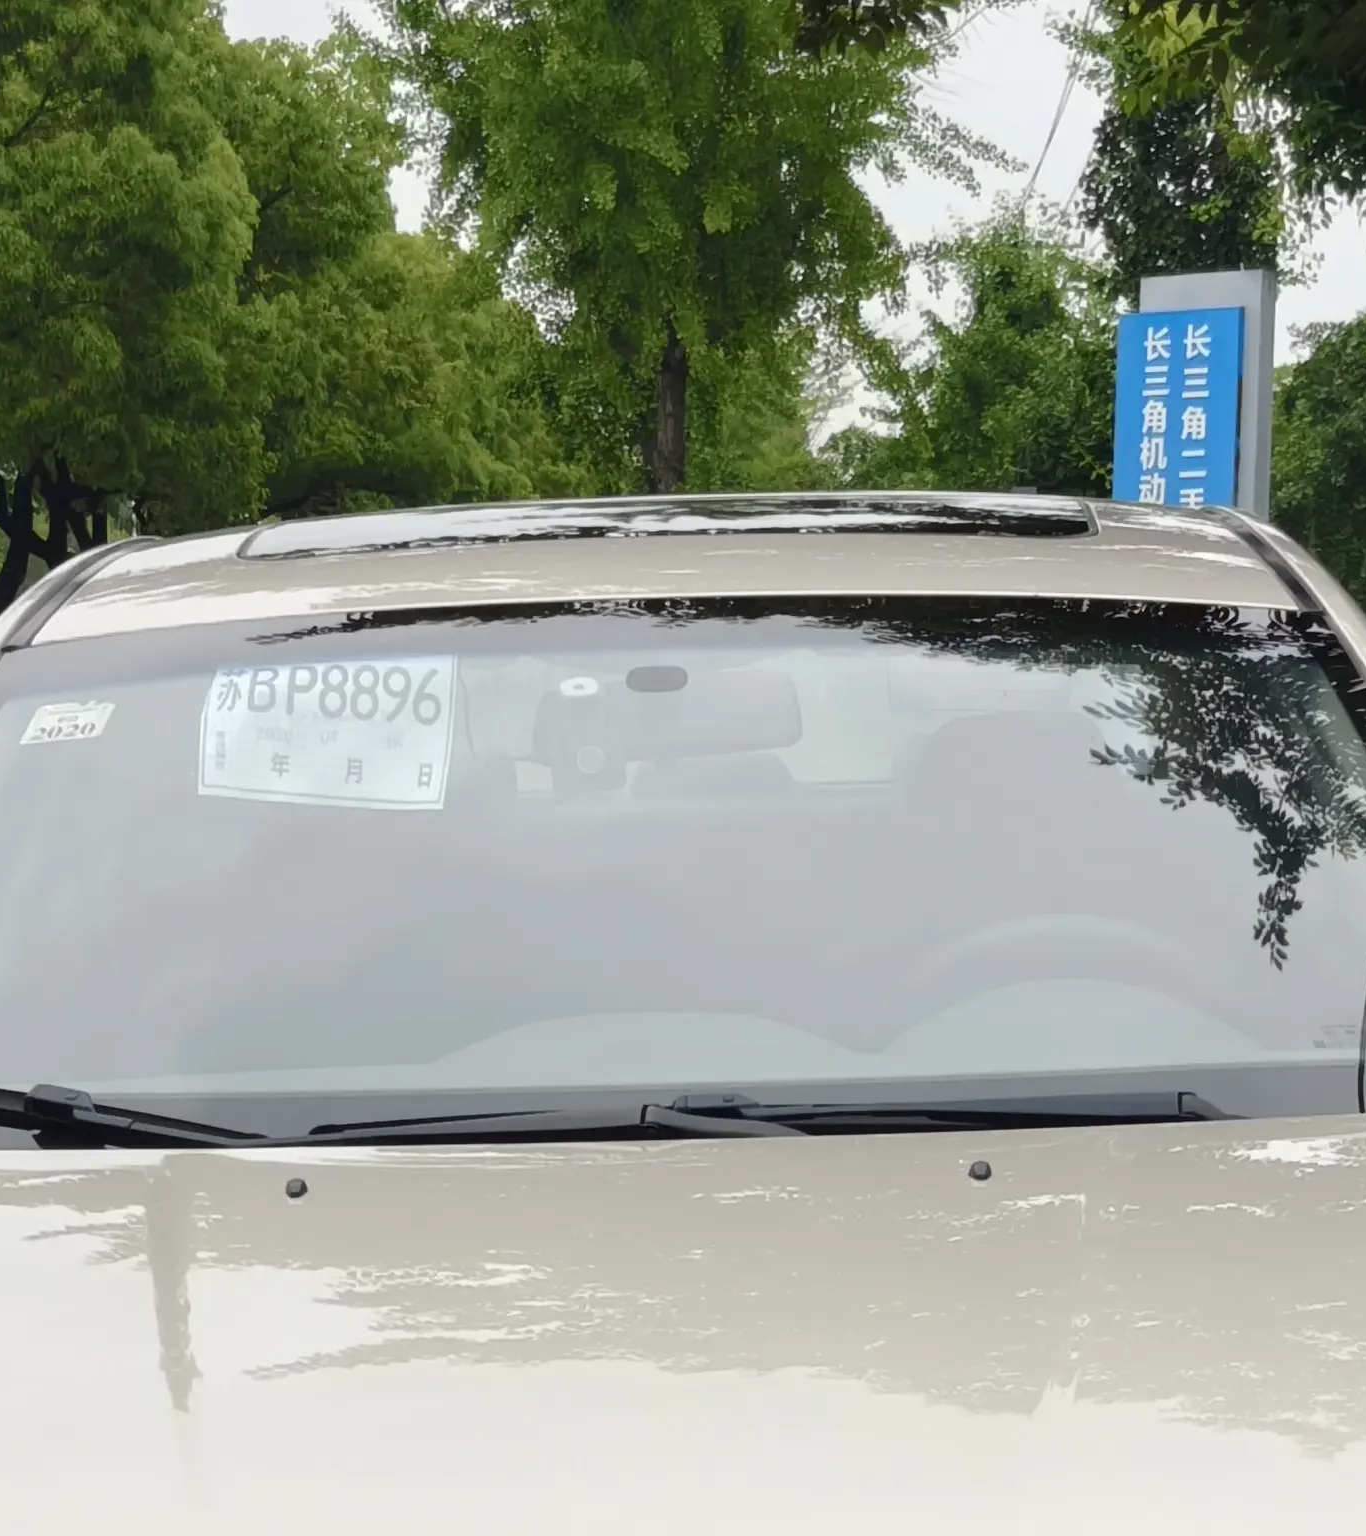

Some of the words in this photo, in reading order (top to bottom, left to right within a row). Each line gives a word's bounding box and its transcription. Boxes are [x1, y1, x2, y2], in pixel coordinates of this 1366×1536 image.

[1138, 326, 1172, 505] 长三角机动
[216, 664, 442, 726] 苏BP8896
[29, 721, 96, 741] 2020
[270, 752, 291, 778] 年
[345, 757, 364, 784] 月
[417, 763, 433, 789] 日
